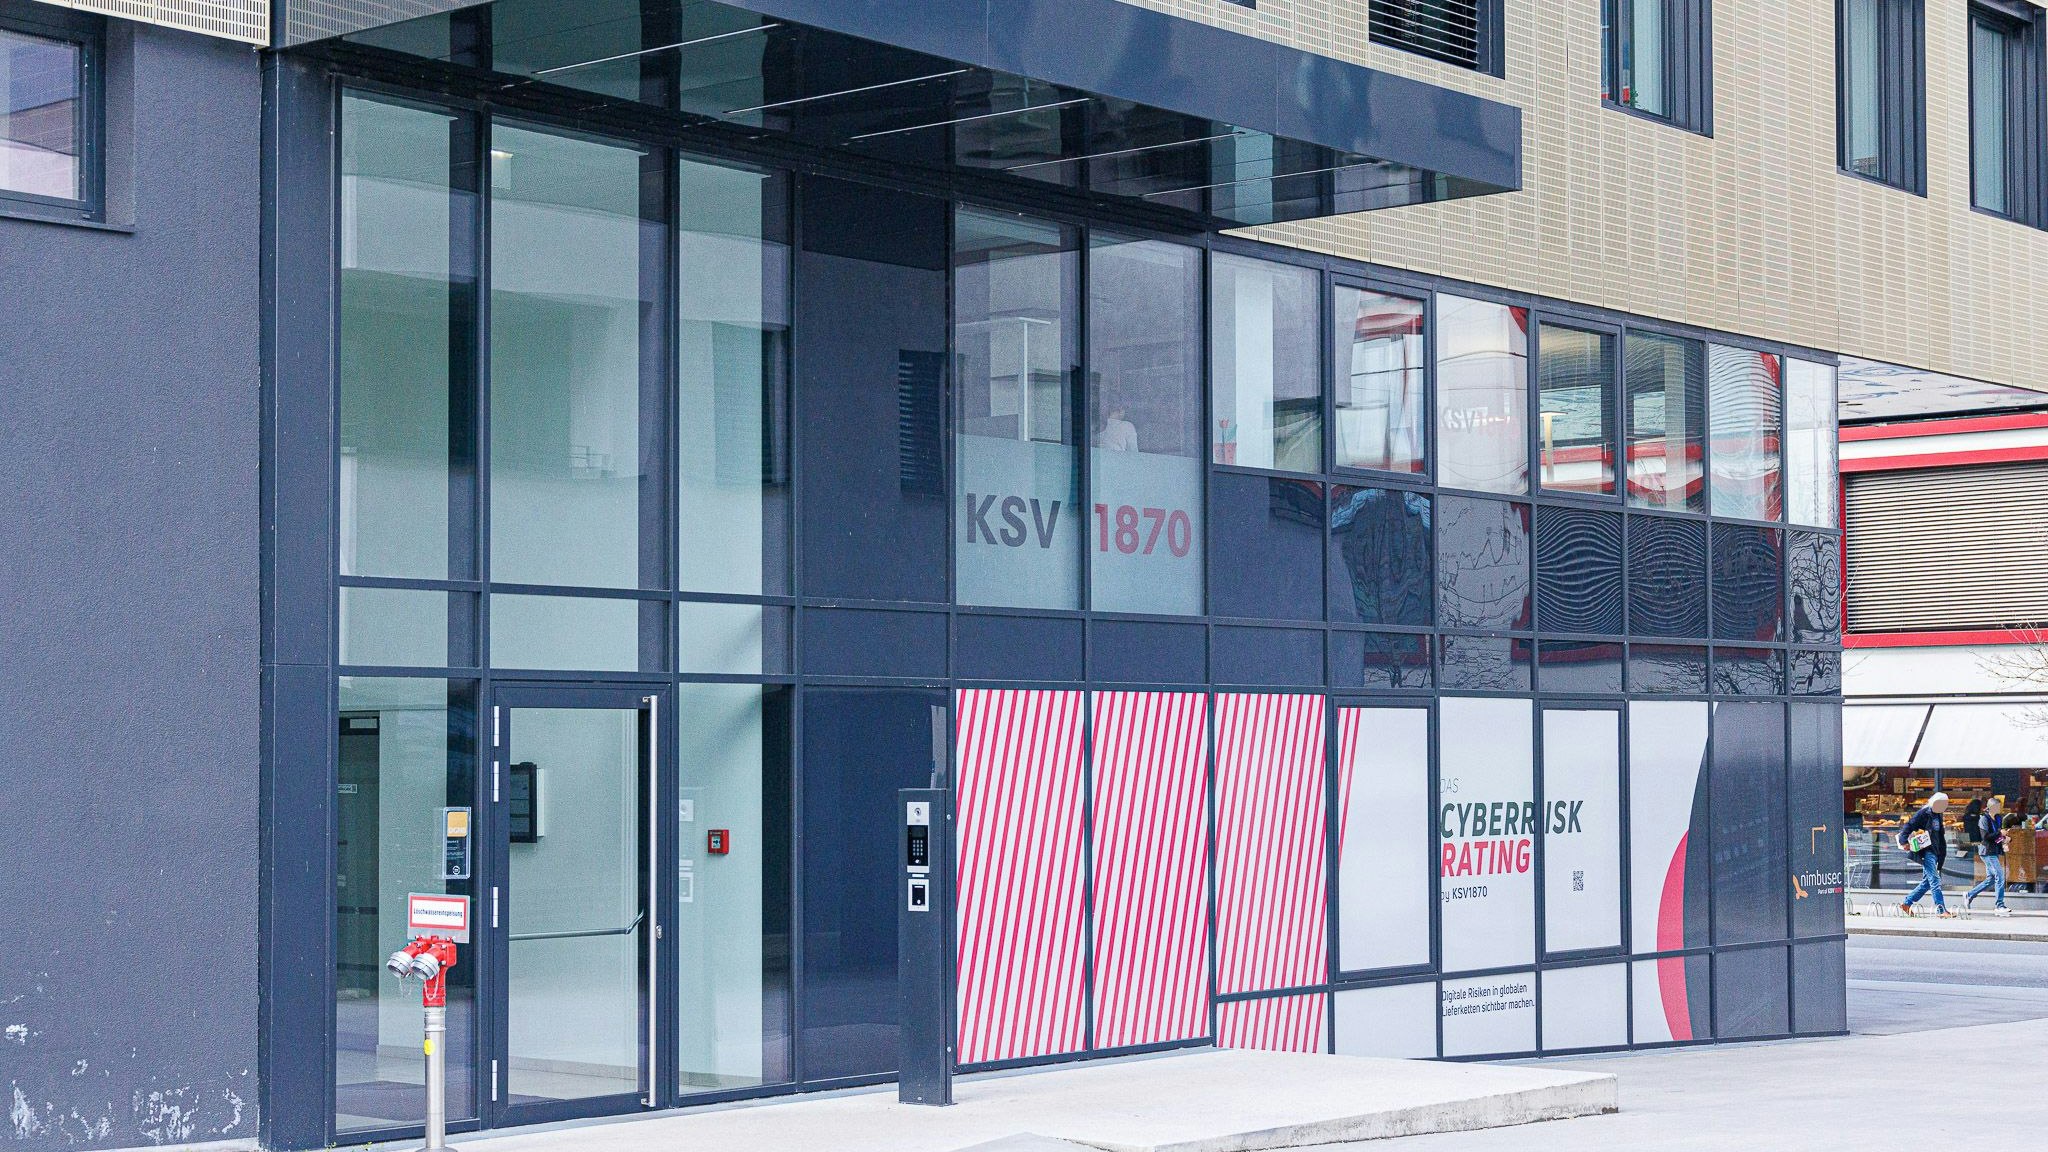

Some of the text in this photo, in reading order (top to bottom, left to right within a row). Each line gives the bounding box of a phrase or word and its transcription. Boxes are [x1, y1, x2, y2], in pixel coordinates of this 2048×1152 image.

[966, 492, 1192, 558] KSV 1870
[1440, 778, 1460, 794] DAS
[1441, 839, 1531, 878] RATING
[1801, 870, 1843, 886] nimbusec
[1452, 886, 1488, 899] KSV1870
[1442, 983, 1527, 1003] Digitale Risiken in globalen
[1442, 1004, 1480, 1017] Lieferketten
[1481, 1001, 1507, 1013] sichtbar
